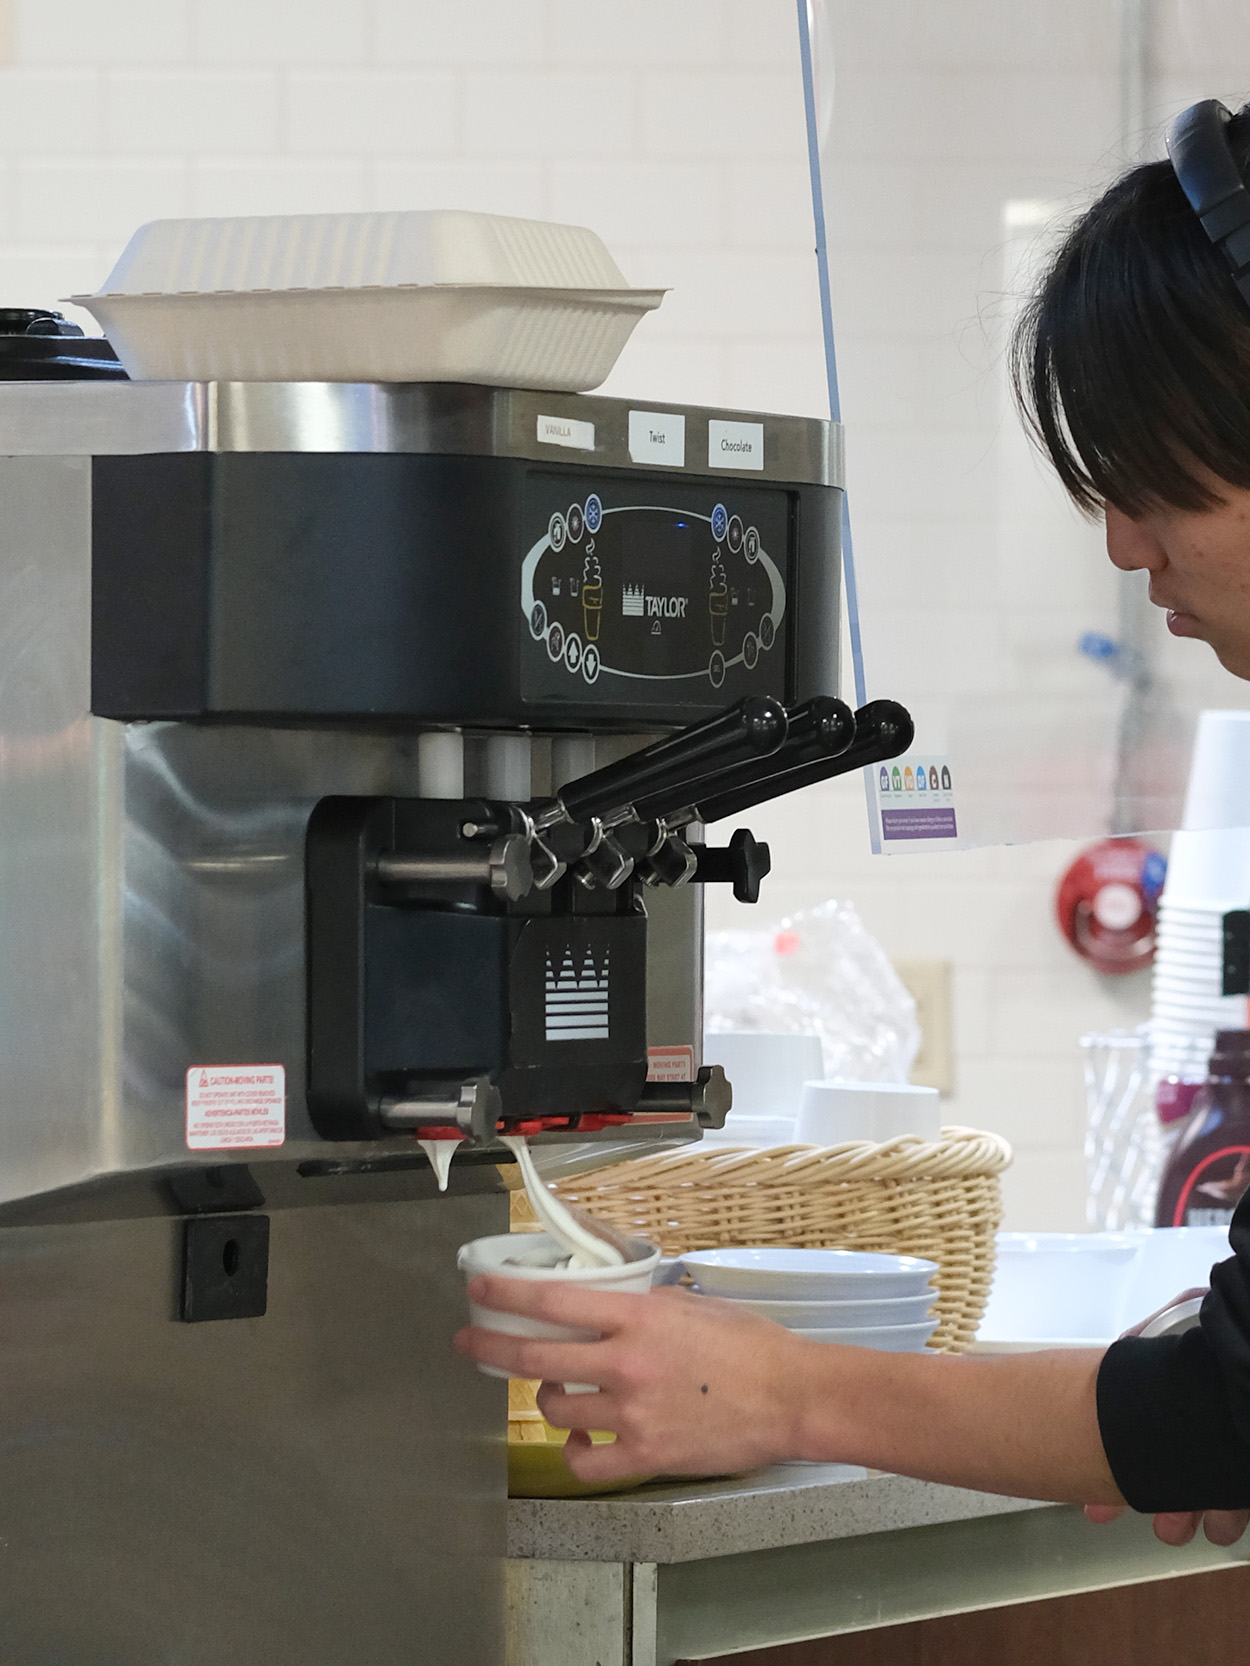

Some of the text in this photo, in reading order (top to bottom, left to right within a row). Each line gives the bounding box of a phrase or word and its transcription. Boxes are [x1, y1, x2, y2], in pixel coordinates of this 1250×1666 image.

[545, 424, 572, 437] VANILLA
[649, 431, 666, 444] Twist
[721, 439, 753, 453] Chocolate
[645, 596, 686, 617] TAYLOR
